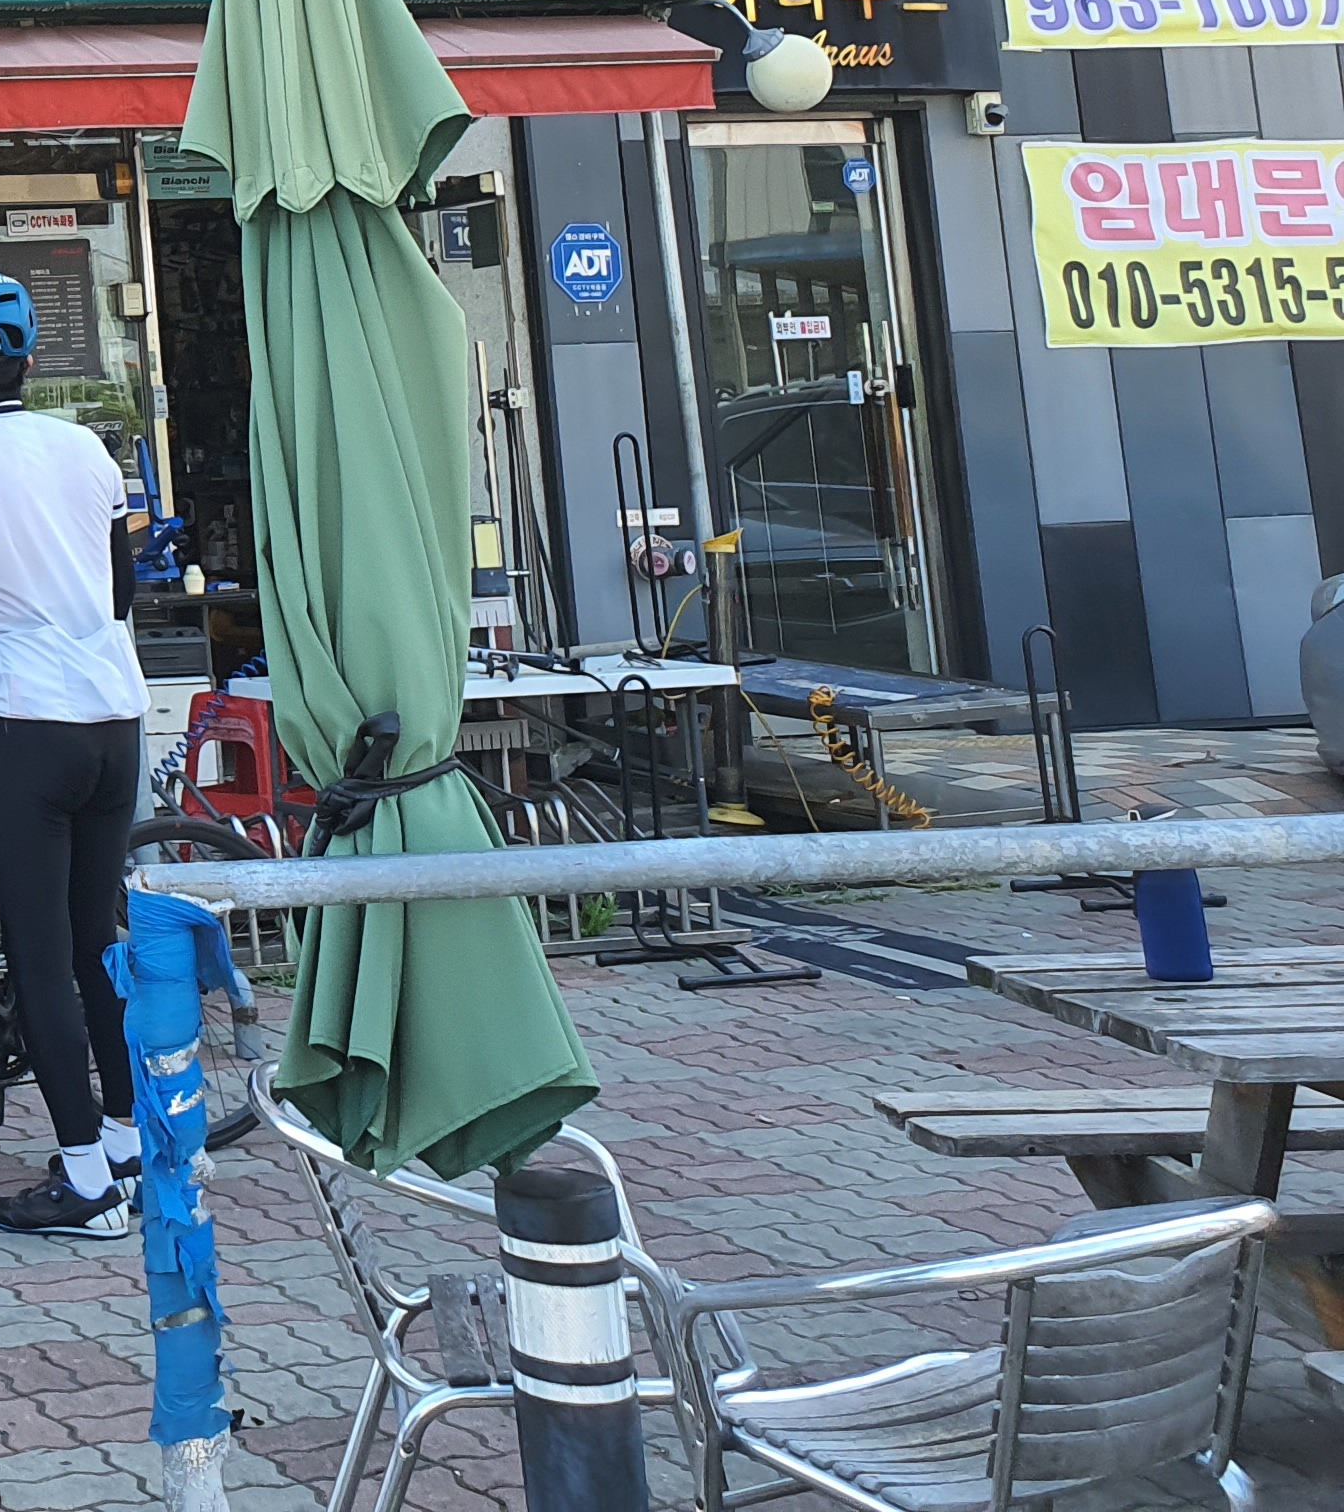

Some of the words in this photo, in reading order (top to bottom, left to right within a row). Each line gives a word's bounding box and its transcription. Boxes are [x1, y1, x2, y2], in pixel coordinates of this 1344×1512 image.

[161, 176, 211, 185] Bianchi
[848, 167, 871, 184] ADT
[1068, 157, 1344, 243] 임대문
[565, 248, 611, 277] ADT
